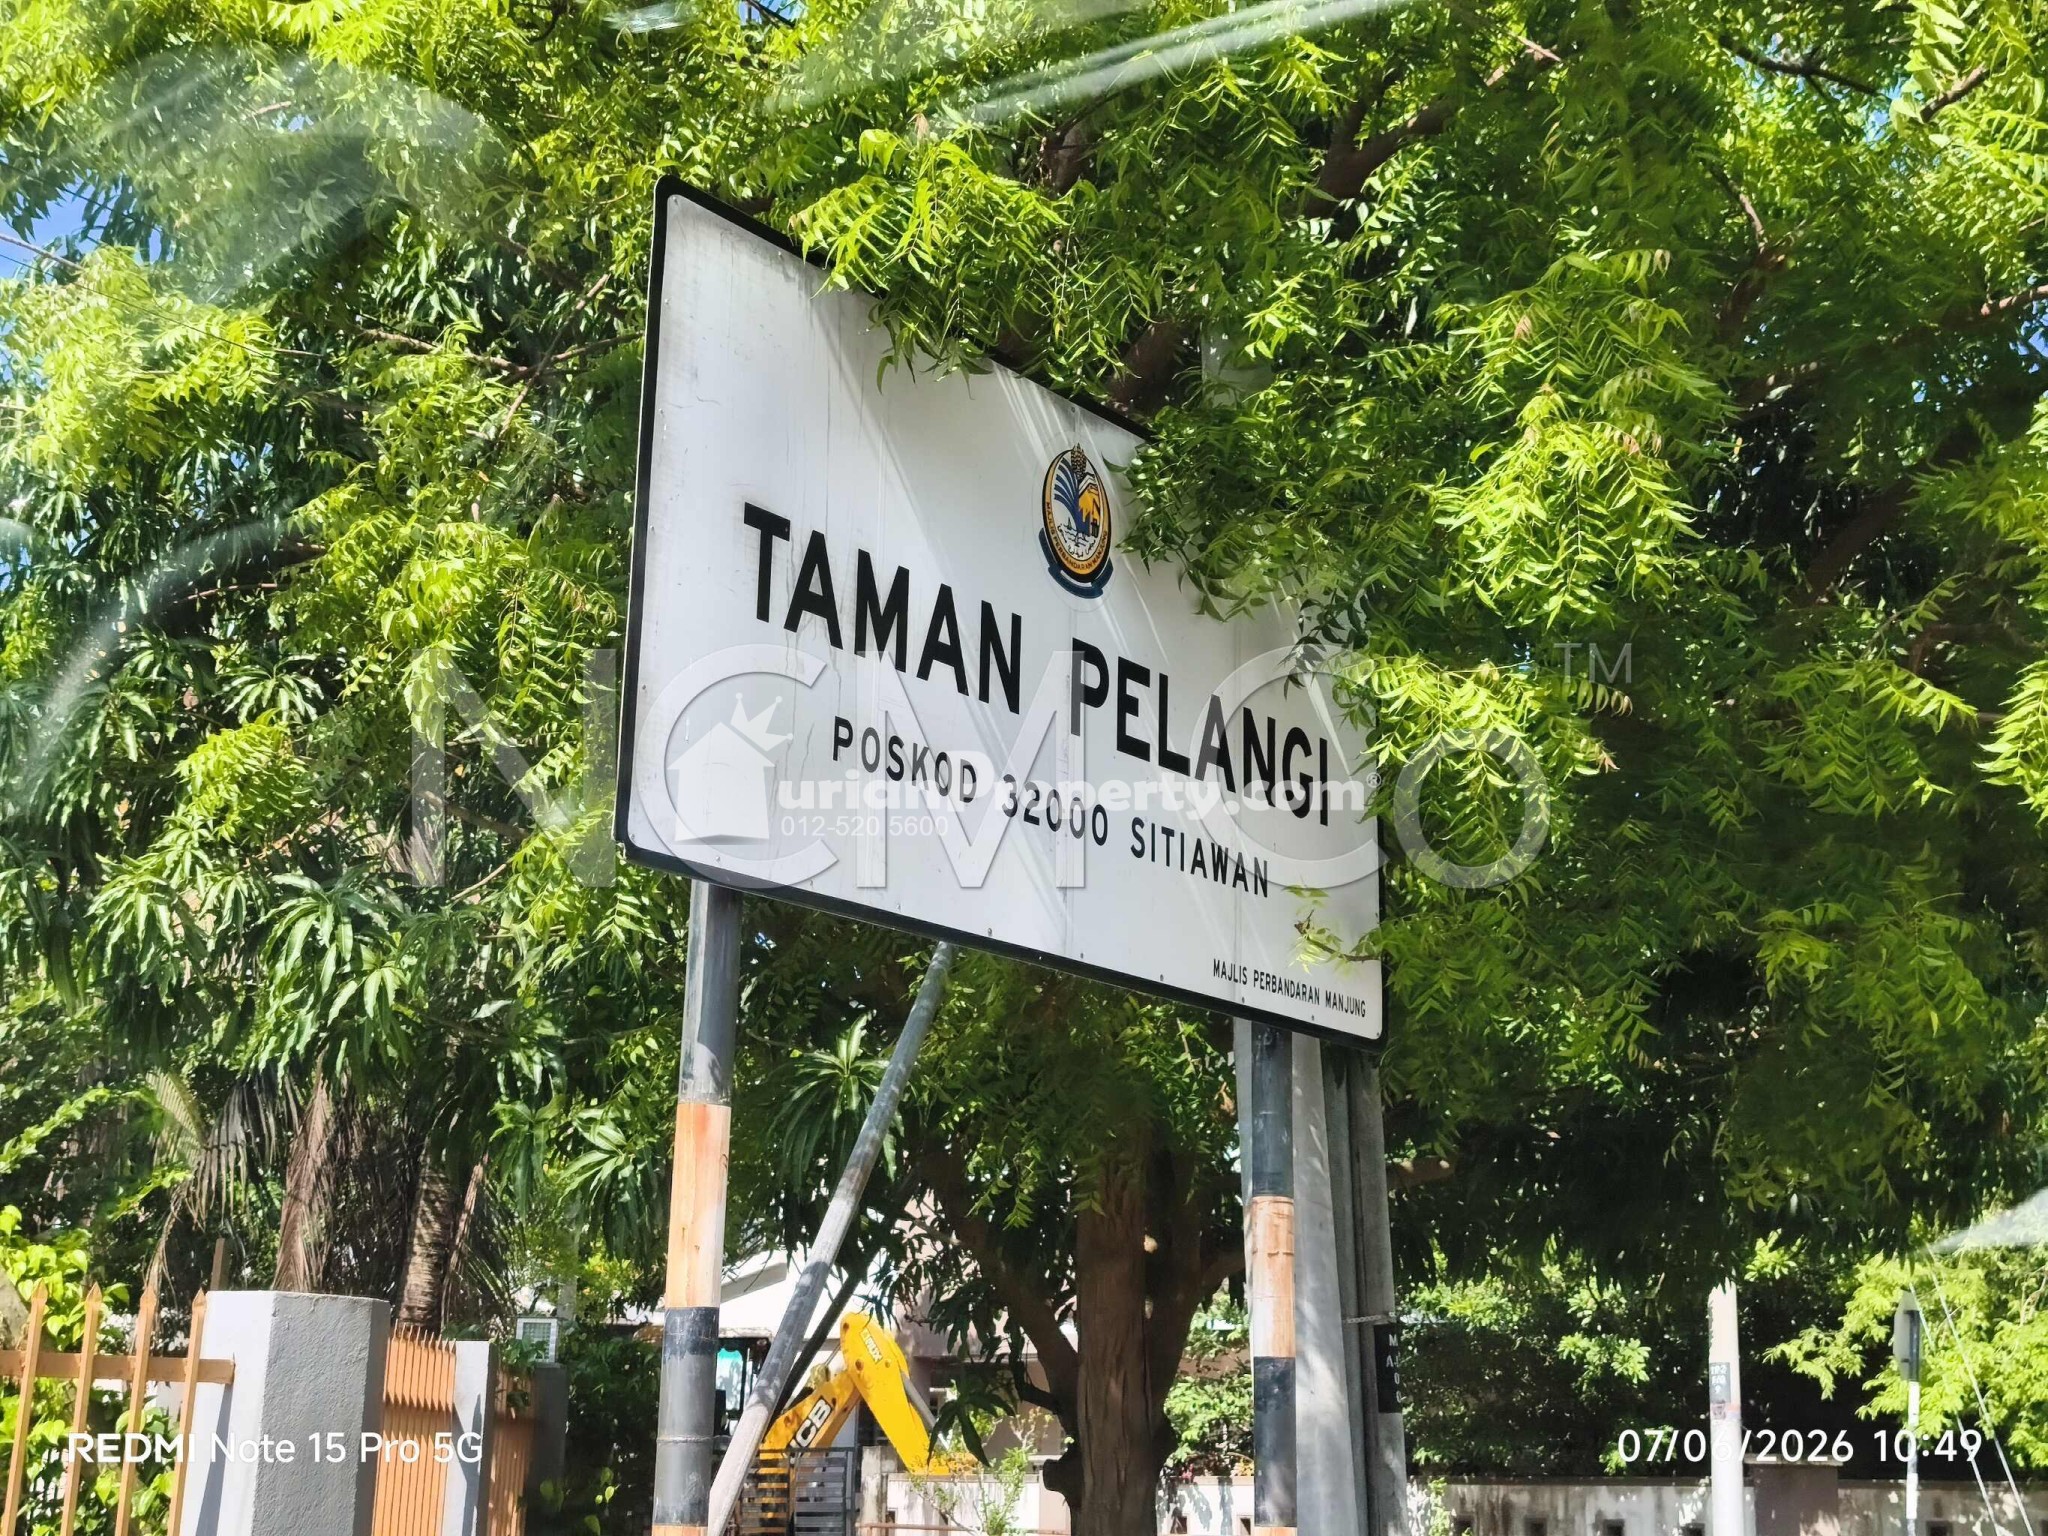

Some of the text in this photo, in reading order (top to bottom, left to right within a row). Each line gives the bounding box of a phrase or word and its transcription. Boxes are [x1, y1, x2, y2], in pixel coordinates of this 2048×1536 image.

[744, 502, 1328, 827] TAMAN PELANGI
[832, 715, 1268, 898] POSKOD 32000 SITIAWAN
[1213, 958, 1366, 1018] MAJLIS PERBANDARAN MANJUNG
